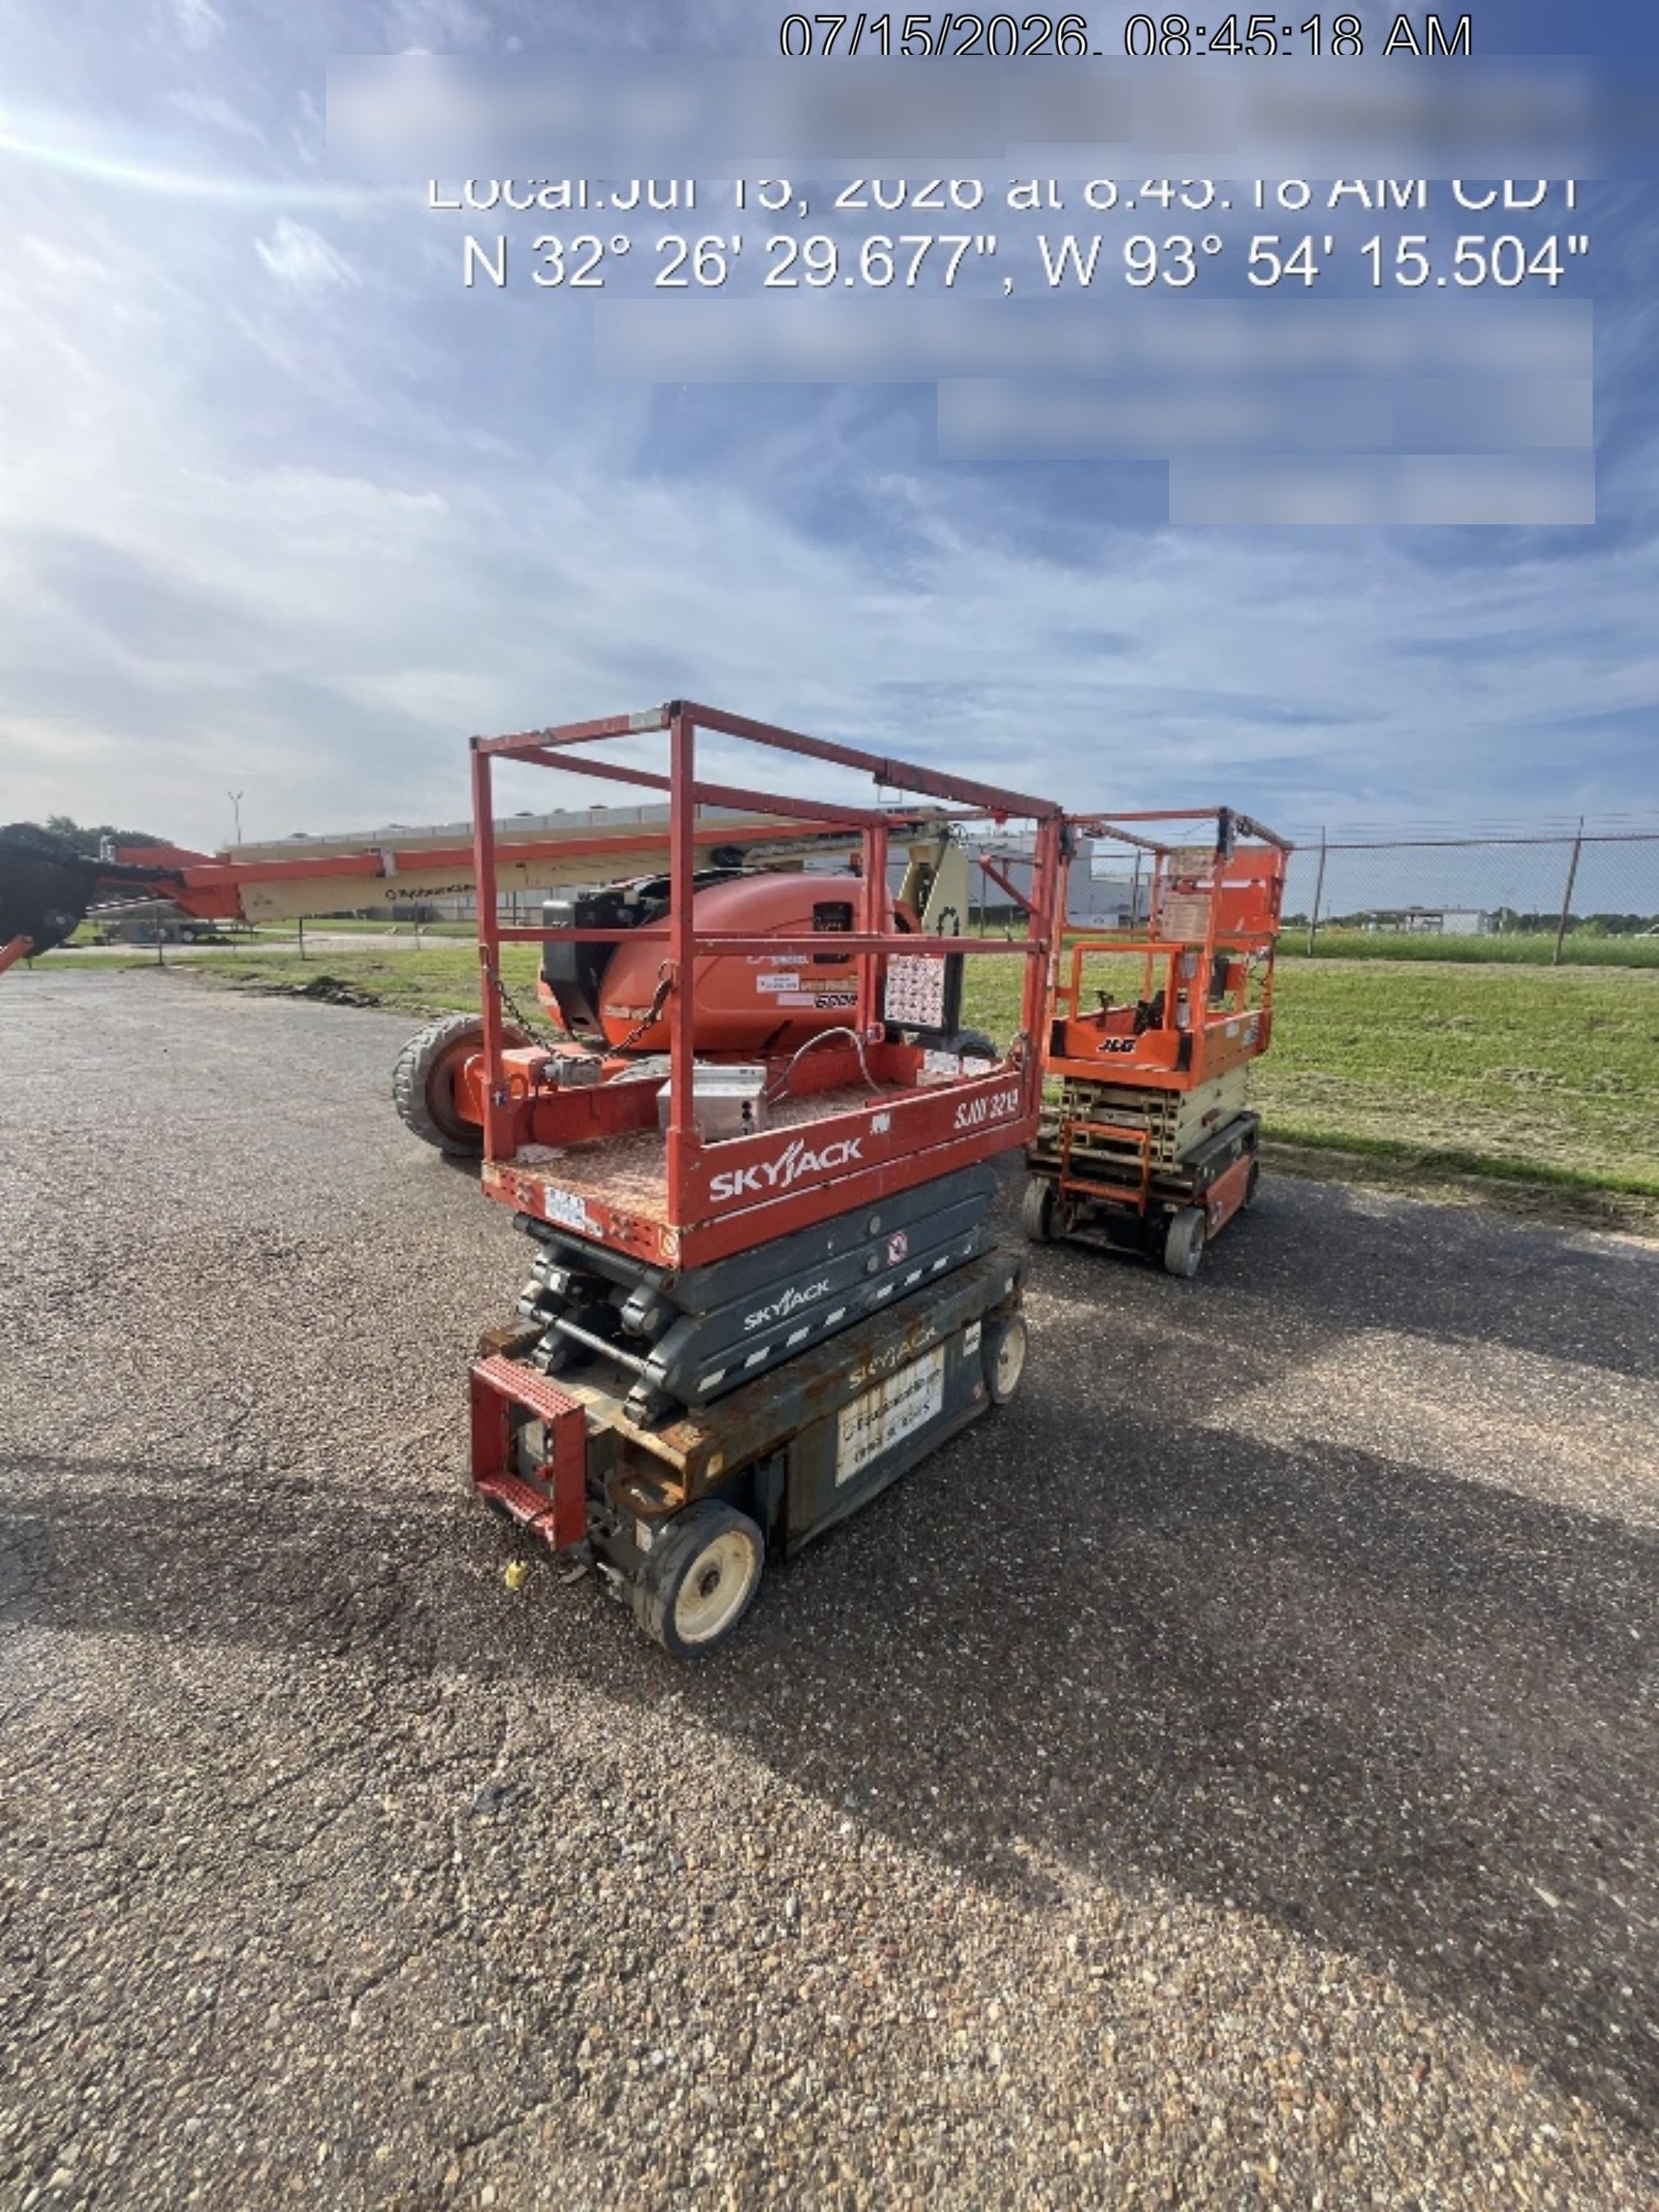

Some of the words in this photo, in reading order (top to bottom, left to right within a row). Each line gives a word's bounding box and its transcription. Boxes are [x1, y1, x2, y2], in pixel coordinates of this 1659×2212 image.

[1098, 1037, 1136, 1054] JLG
[709, 1136, 863, 1203] SKYJACK
[743, 1277, 830, 1331] SKYJACK
